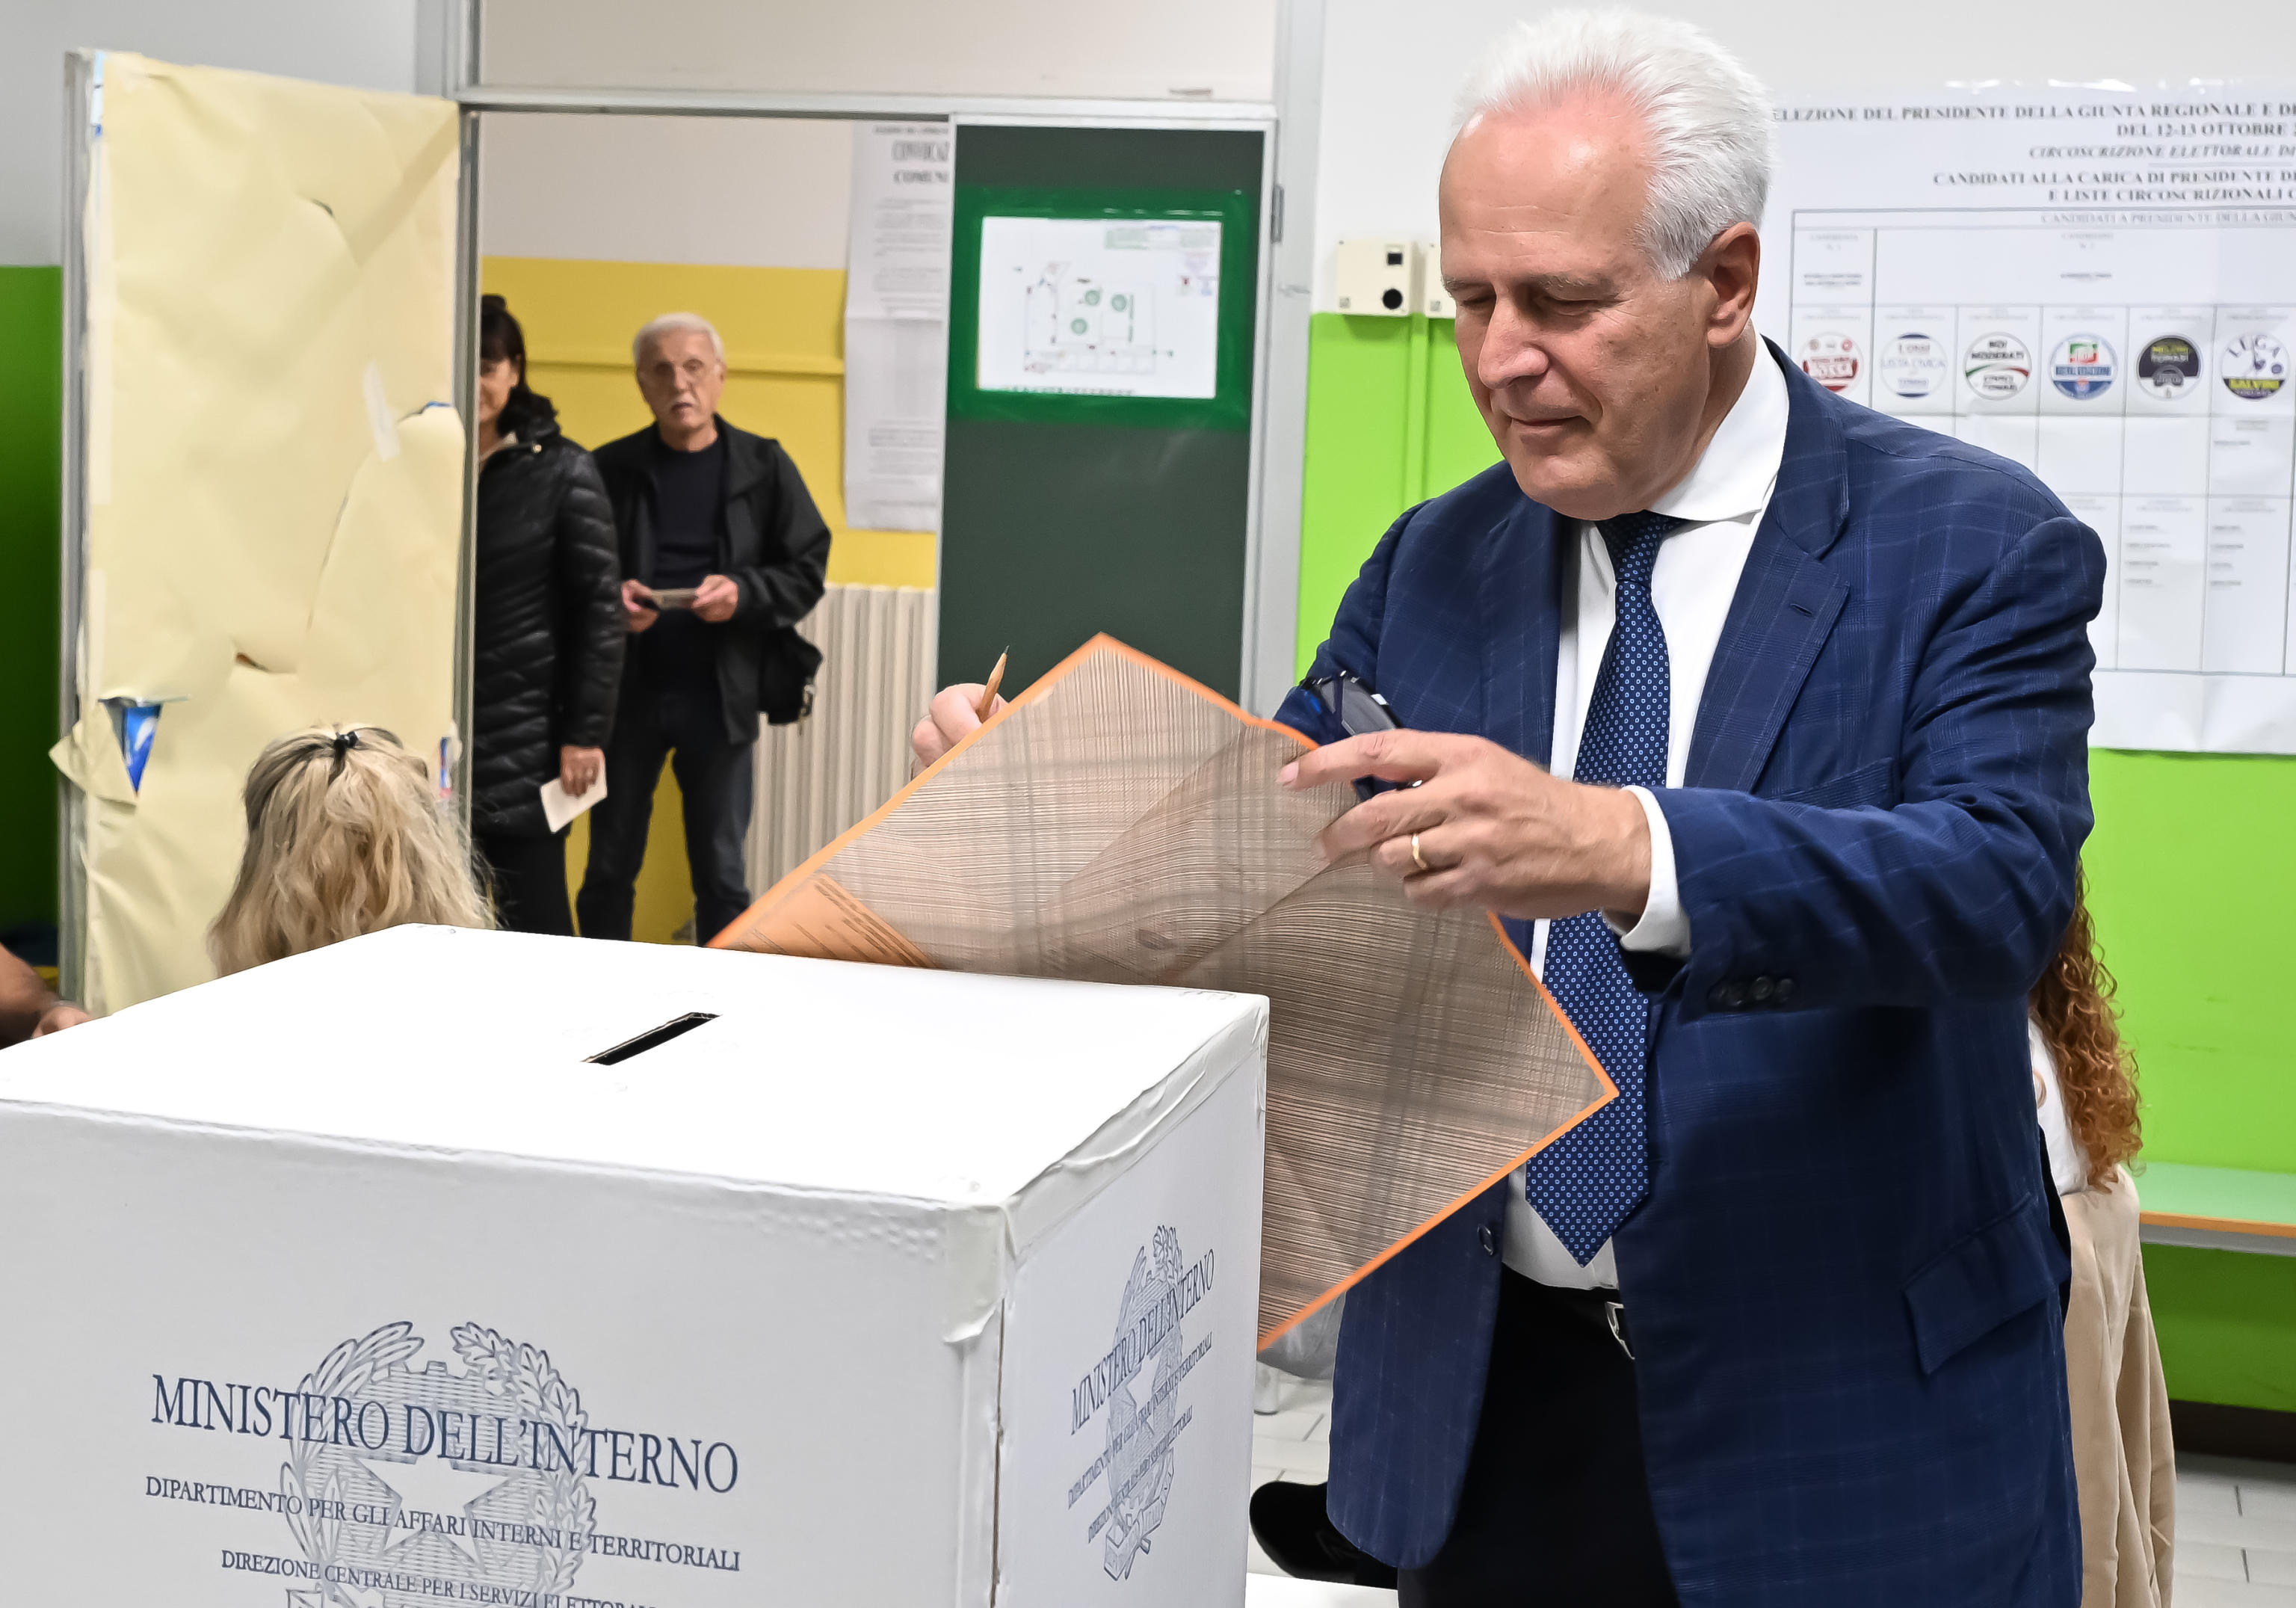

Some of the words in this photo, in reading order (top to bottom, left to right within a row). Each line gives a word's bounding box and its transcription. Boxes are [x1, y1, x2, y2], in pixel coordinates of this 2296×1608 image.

[1863, 107, 1895, 120] DEL
[1901, 106, 2009, 120] PRESIDENTE
[2016, 105, 2073, 119] DELLA
[2078, 104, 2145, 118] GIUNTA
[2151, 103, 2257, 117] REGIONALE
[2262, 103, 2272, 116] E
[2117, 123, 2151, 137] DEL
[2157, 123, 2197, 137] 12-13
[2201, 122, 2287, 136] OTTOBRE
[2028, 144, 2164, 158] CIRCOSCRIZIONE
[2170, 144, 2274, 156] ELETTORALE
[1933, 172, 2025, 185] CANDIDATI
[2032, 171, 2073, 184] ALLA
[2078, 171, 2143, 184] CARICA
[2147, 171, 2165, 183] DI
[2170, 170, 2274, 182] PRESIDENTE
[2049, 189, 2058, 202] E
[2064, 189, 2110, 201] LISTE
[1070, 1328, 1137, 1436] MINISTERO
[1138, 1248, 1215, 1364] DELL'INTERNO
[151, 1374, 389, 1451] MINISTERO
[401, 1404, 739, 1494] DELL'INTERNO
[146, 1476, 303, 1516] DIPARTIMENTO
[309, 1497, 348, 1521] PER
[353, 1503, 389, 1527] GLI
[394, 1510, 466, 1536] AFFARI
[472, 1518, 562, 1550] INTERNI
[568, 1531, 583, 1552] E
[588, 1533, 741, 1572] TERRITORIALI
[221, 1549, 321, 1580] DIREZIONE
[324, 1564, 419, 1593] CENTRALE
[422, 1577, 454, 1598] PER
[460, 1583, 466, 1600] I
[469, 1584, 539, 1608] SERVIZI
